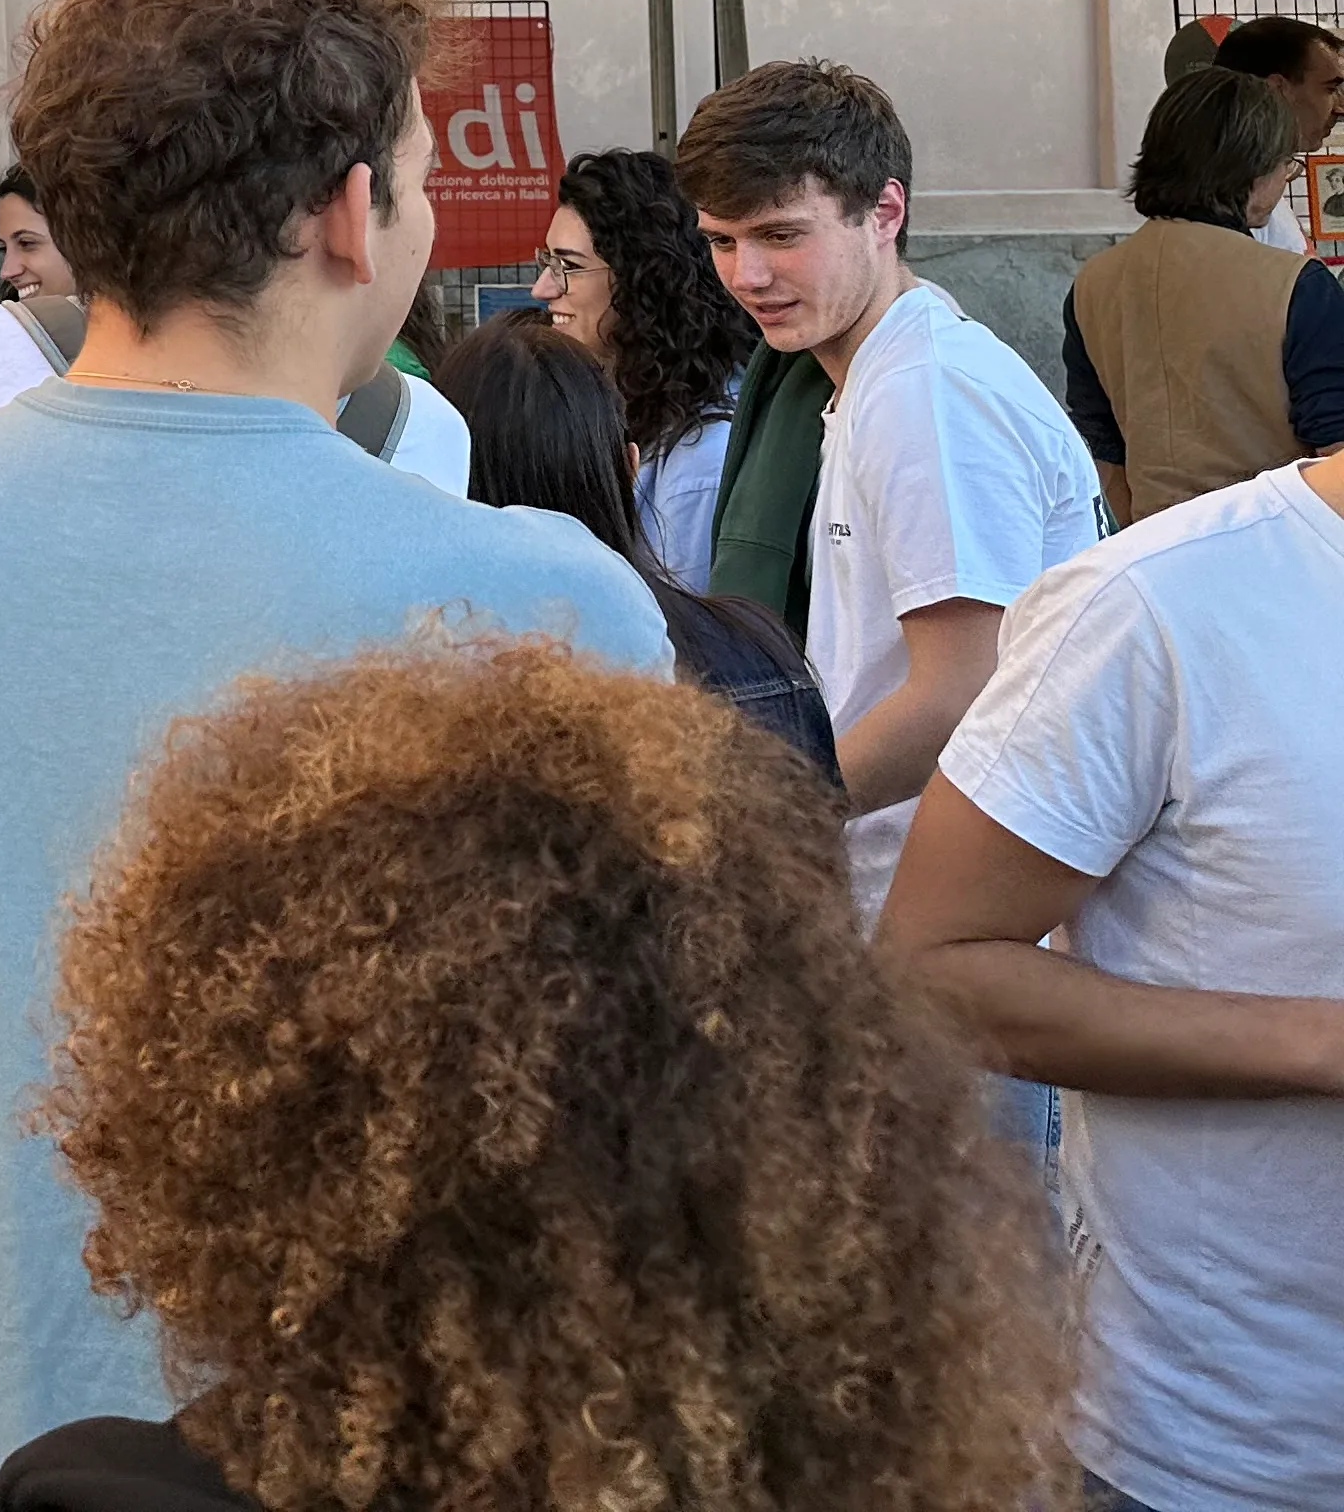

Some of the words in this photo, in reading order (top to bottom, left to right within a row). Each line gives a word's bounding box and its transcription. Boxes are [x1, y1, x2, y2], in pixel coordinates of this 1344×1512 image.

[432, 82, 547, 169] di
[425, 174, 472, 187] azione
[479, 173, 550, 187] dottorandi
[440, 189, 453, 201] di
[456, 189, 501, 201] ricerca
[504, 190, 516, 200] in
[519, 189, 550, 200] Italia
